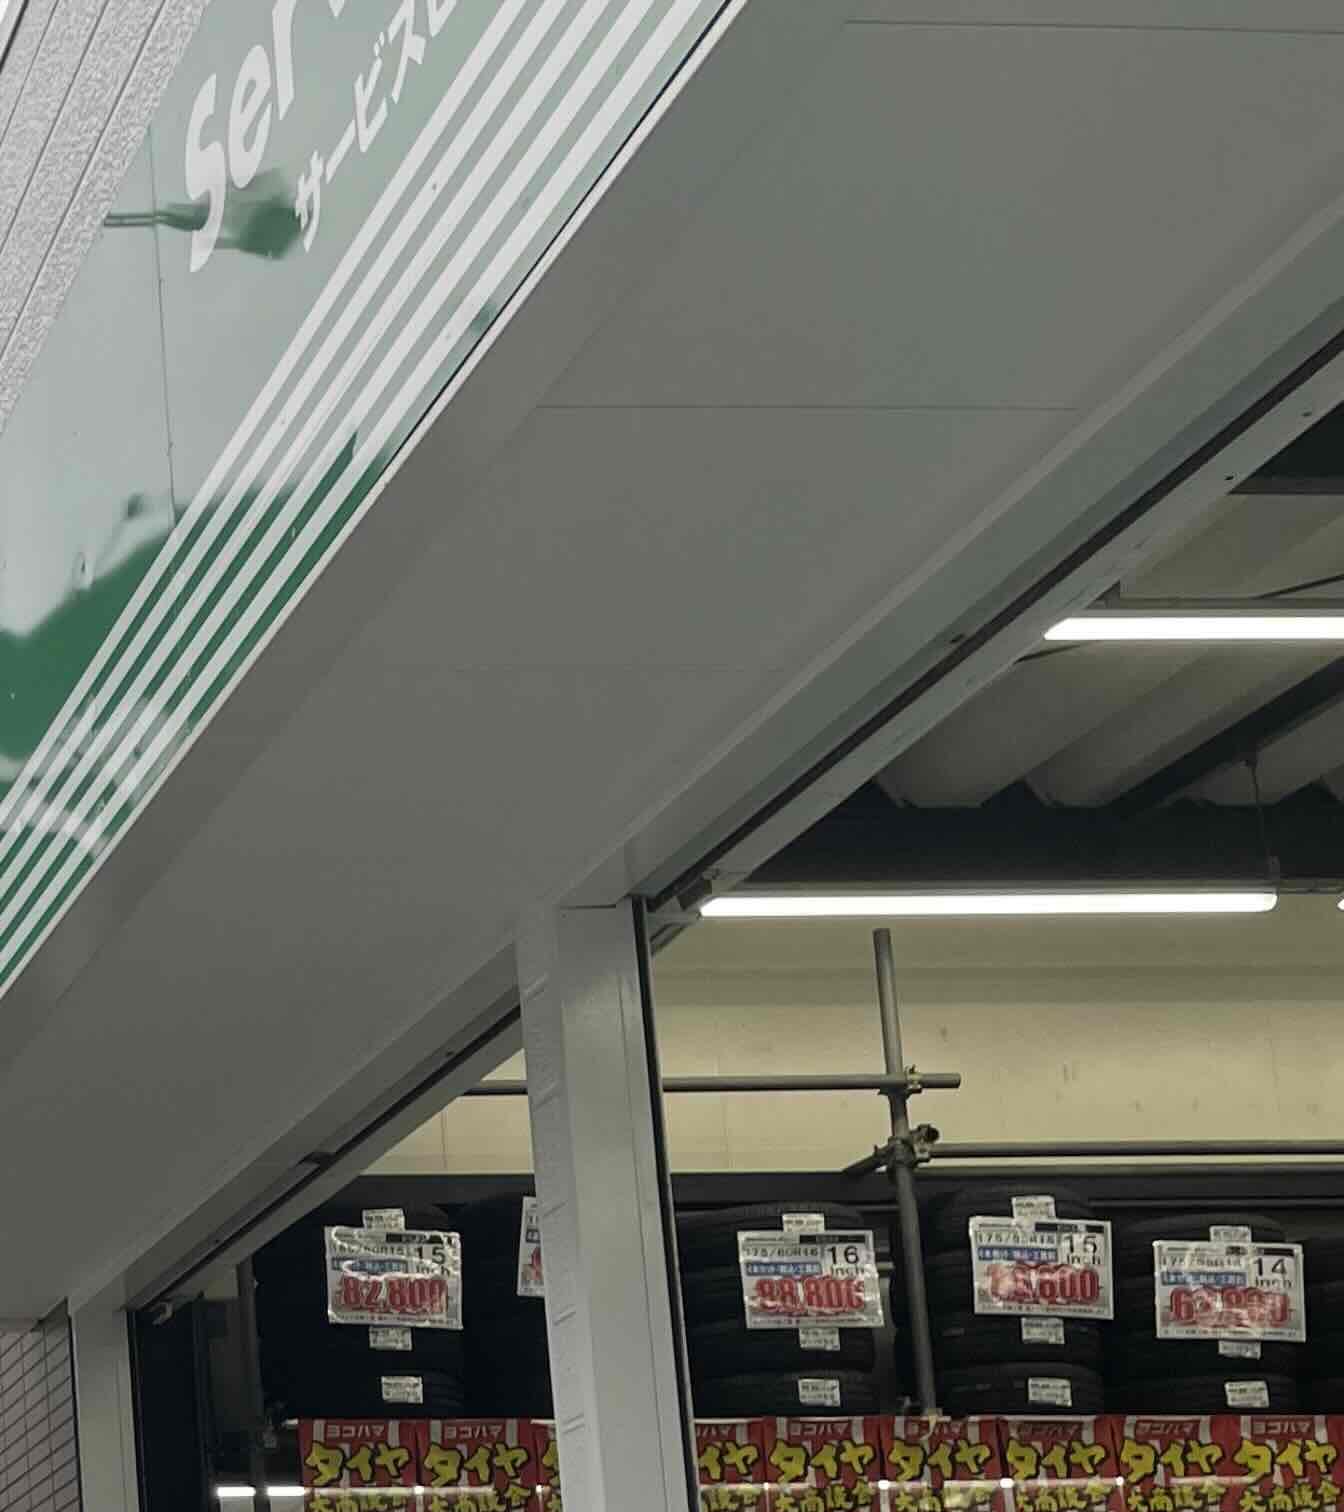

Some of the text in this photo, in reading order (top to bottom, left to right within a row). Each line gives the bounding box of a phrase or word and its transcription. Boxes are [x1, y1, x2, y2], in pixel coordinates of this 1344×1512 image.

[185, 0, 345, 272] Ser
[413, 1246, 446, 1265] 15
[829, 1245, 861, 1265] 16
[1063, 1235, 1098, 1254] 15
[1254, 1257, 1288, 1277] 14
[444, 1423, 503, 1439] ヨコハマ
[305, 1440, 411, 1488] タイヤ
[424, 1440, 530, 1489] タイヤ
[696, 1438, 760, 1482] イヤ
[769, 1438, 875, 1485] タイヤ
[888, 1438, 993, 1484] タイヤ
[1006, 1436, 1107, 1480] タイヤ
[1120, 1437, 1224, 1484] タイヤ
[1233, 1437, 1337, 1481] タイヤ
